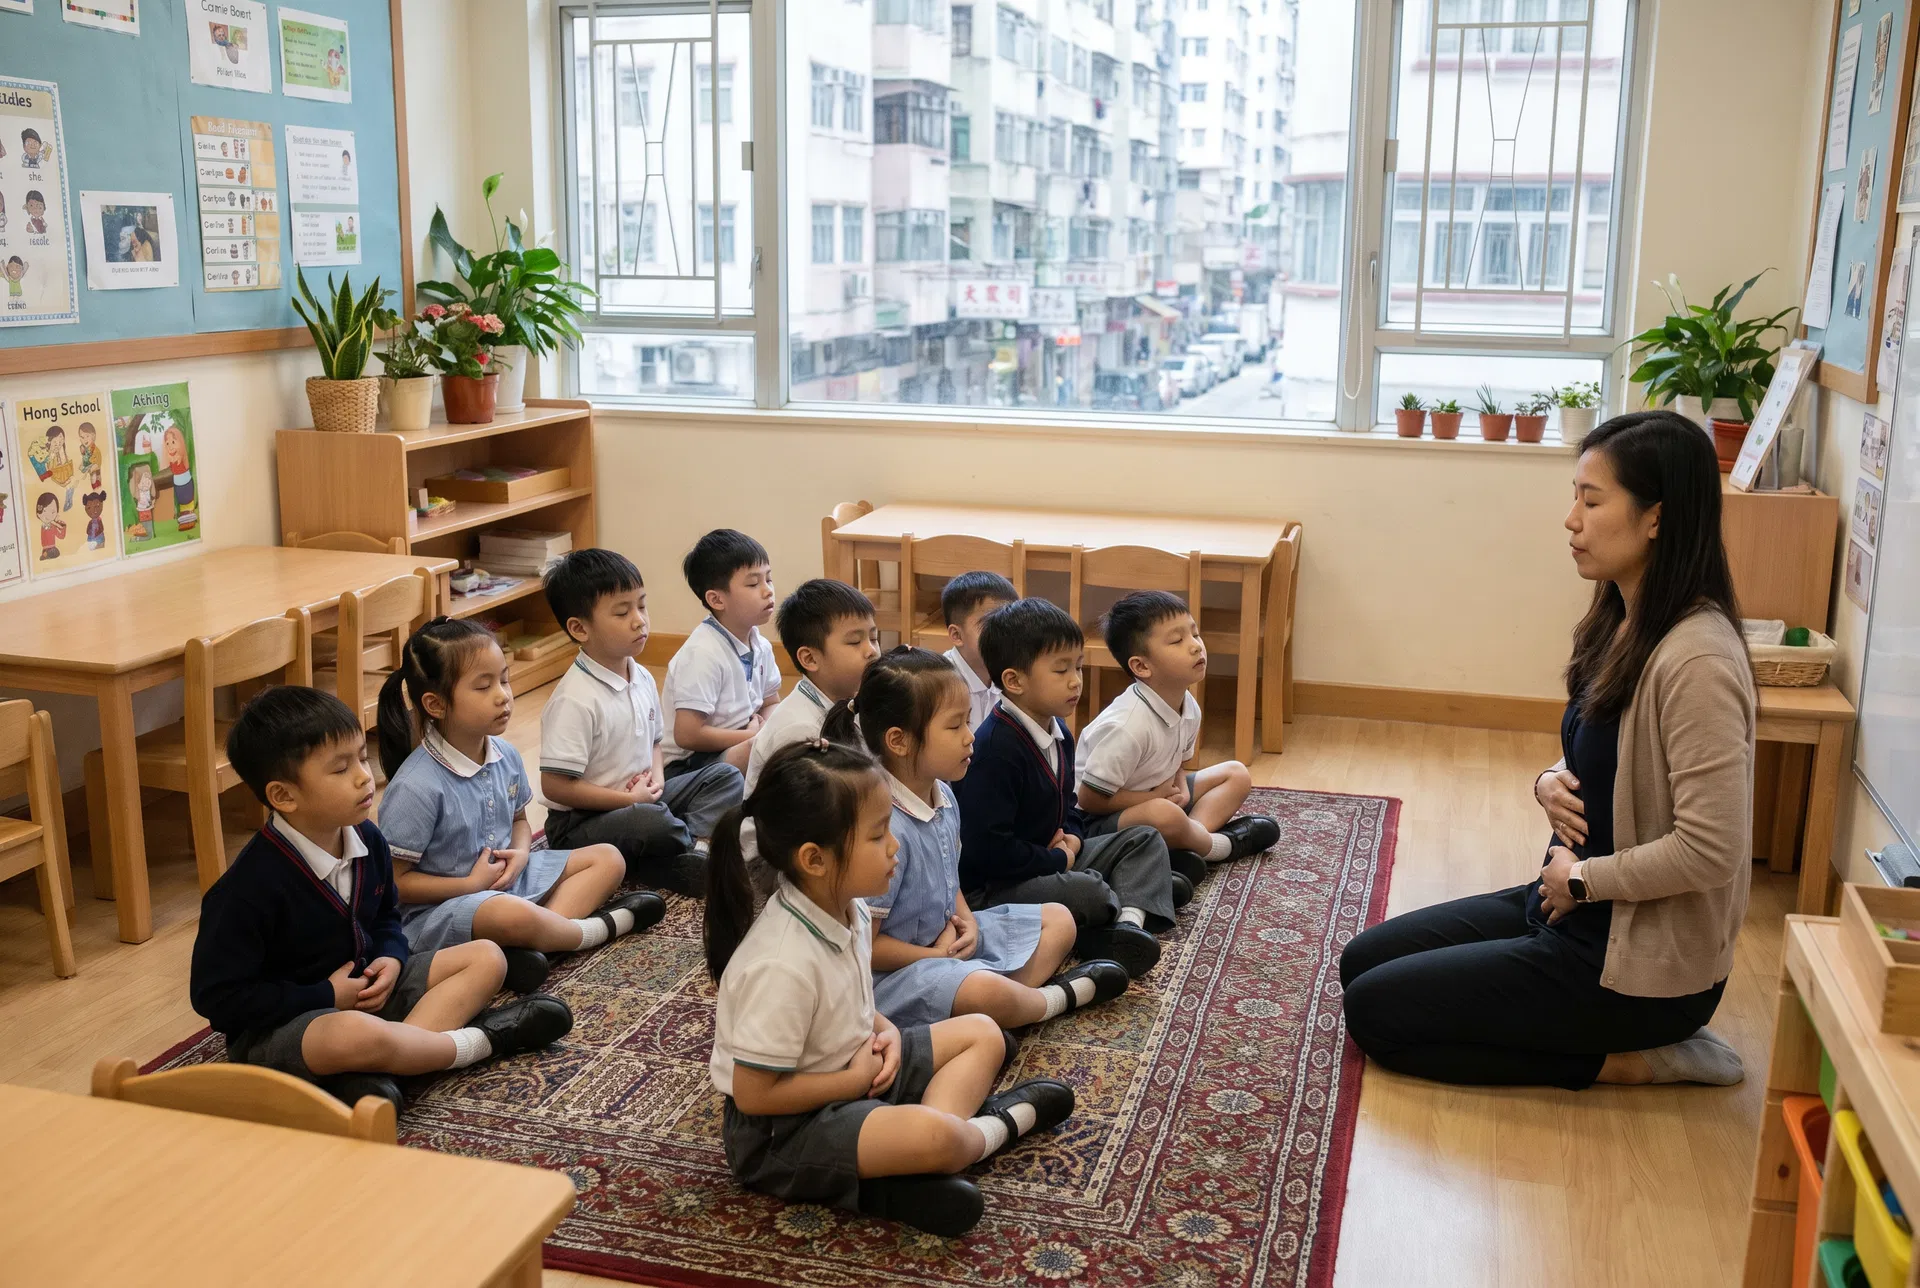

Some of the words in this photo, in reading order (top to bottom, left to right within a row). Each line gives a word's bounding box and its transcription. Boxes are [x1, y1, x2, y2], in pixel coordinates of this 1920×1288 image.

[23, 407, 57, 422] Hong
[61, 398, 101, 415] School
[132, 393, 169, 408] Athing
